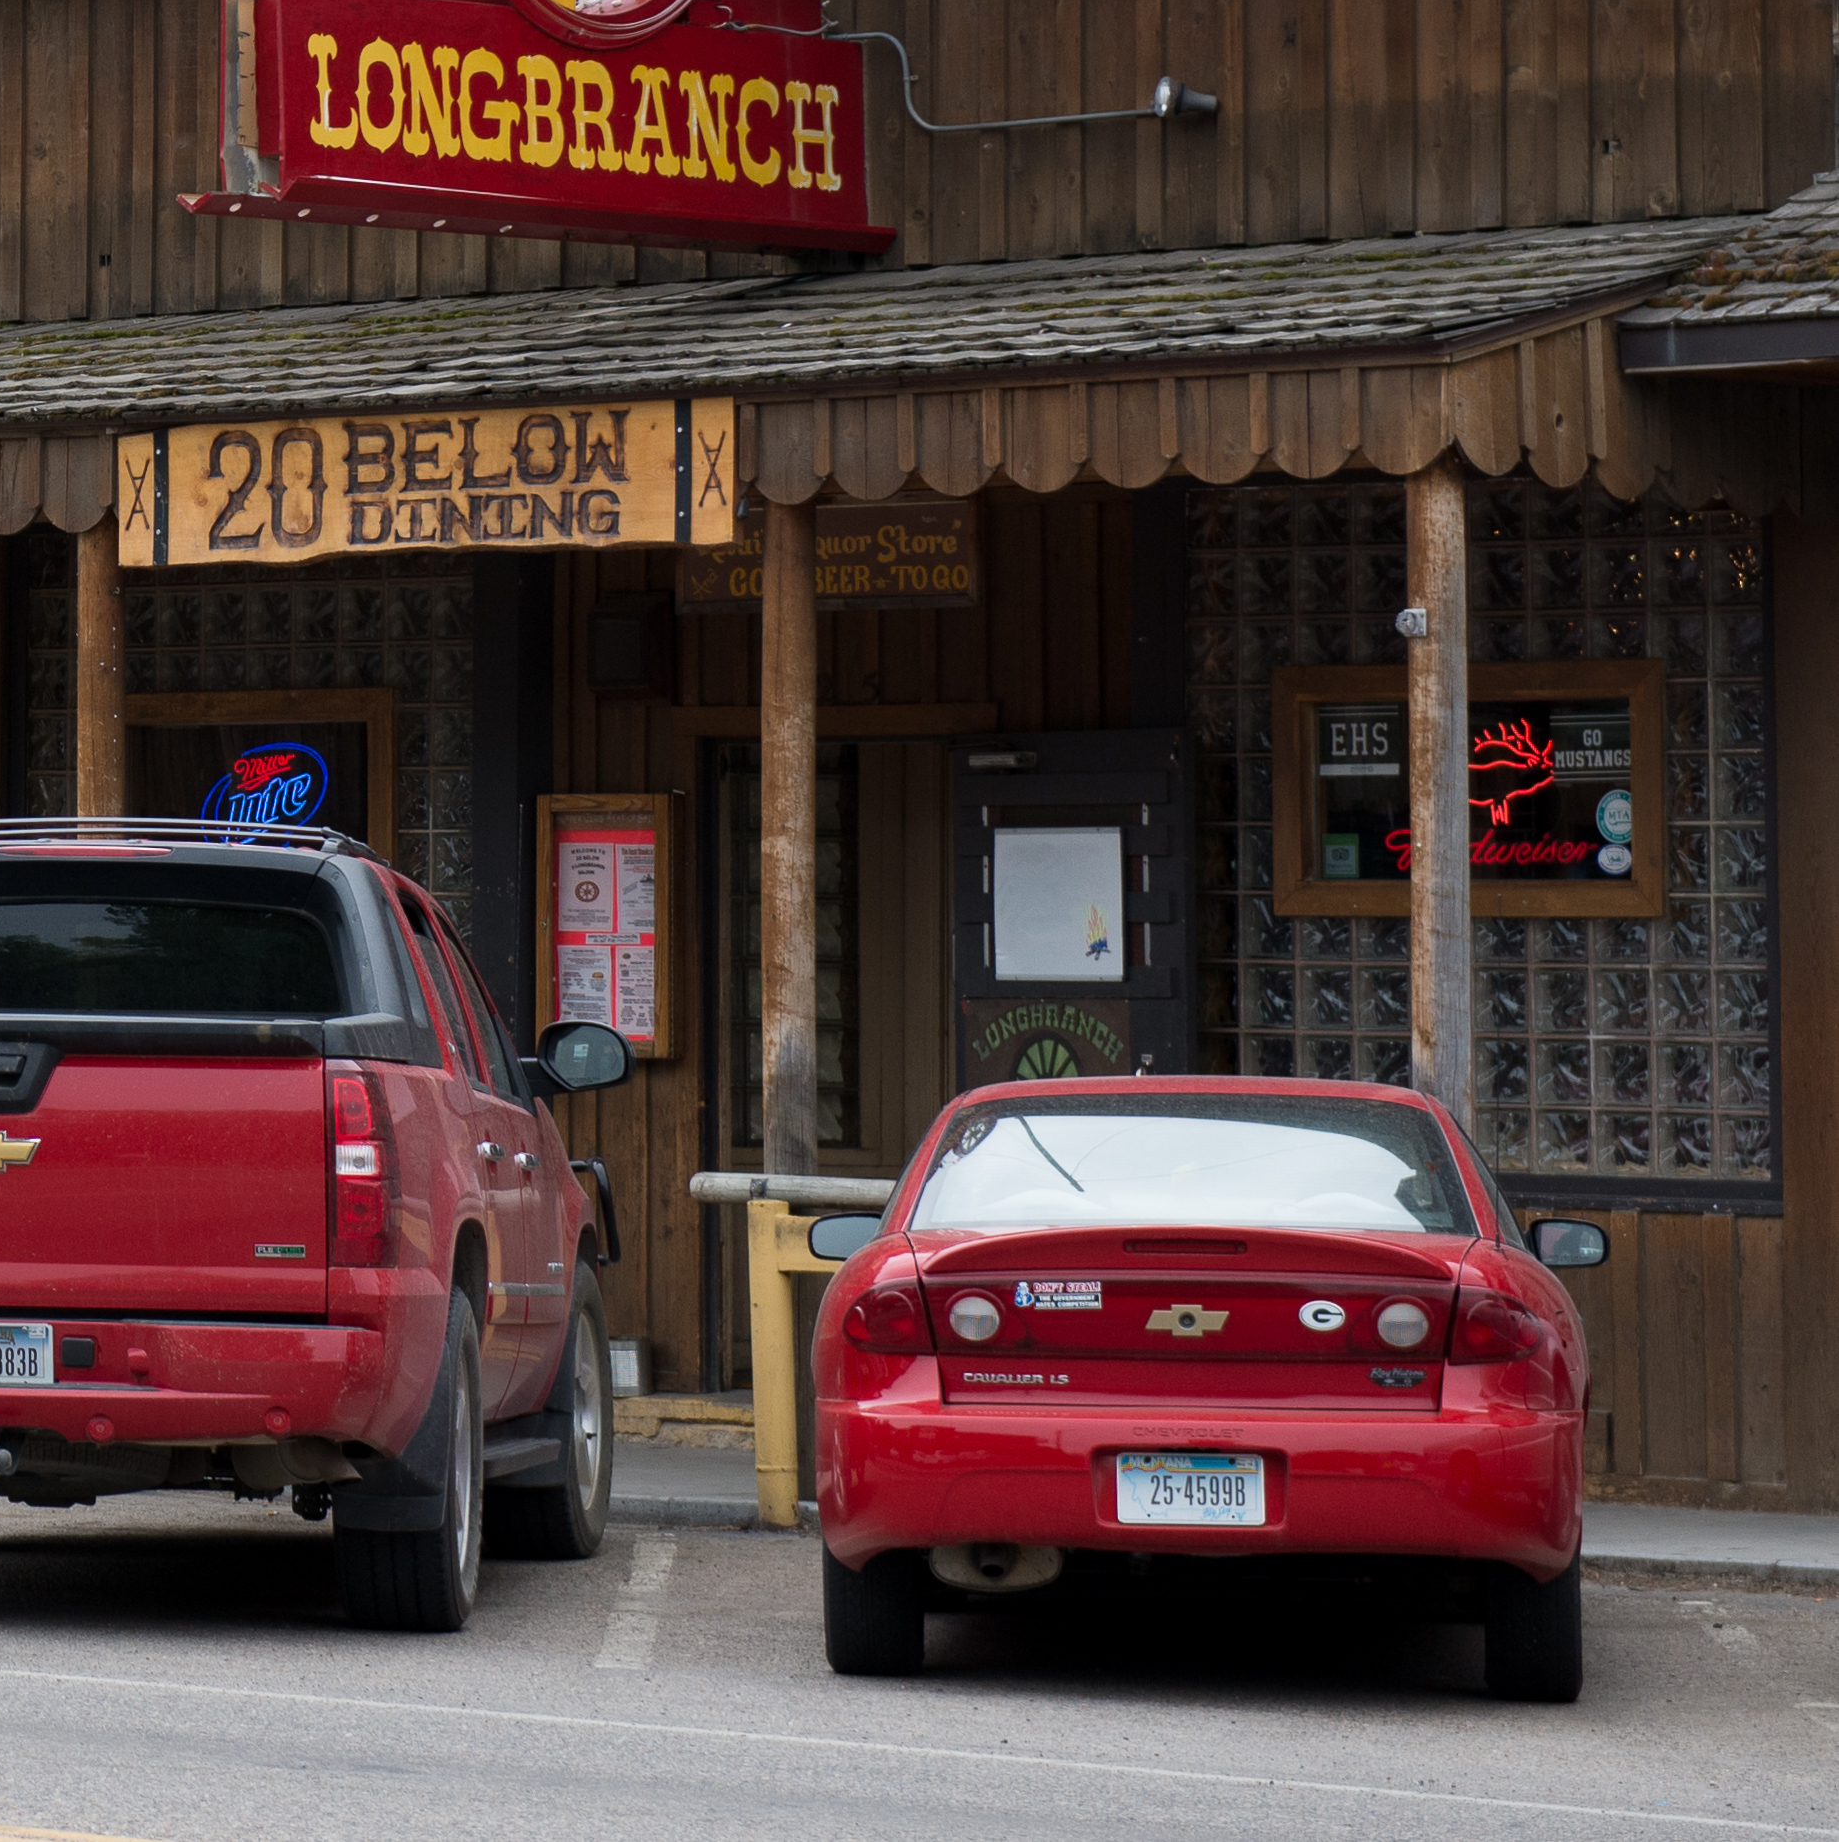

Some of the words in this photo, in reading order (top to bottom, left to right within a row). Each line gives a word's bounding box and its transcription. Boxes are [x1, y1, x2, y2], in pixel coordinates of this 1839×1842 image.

[306, 32, 842, 193] LONGBRANCH
[342, 409, 631, 496] BELOW
[207, 428, 328, 551] 20
[348, 488, 621, 546] DINING
[1330, 723, 1389, 756] EHS
[1582, 729, 1602, 747] GO
[1554, 749, 1631, 768] MUSTANGS
[1385, 829, 1599, 871] dweiser
[1033, 1281, 1065, 1293] DON'T
[1065, 1280, 1101, 1293] STEAL!
[963, 1372, 1043, 1385] CAVALIER
[1049, 1374, 1070, 1385] LS
[1132, 1425, 1244, 1439] CHEVROLET
